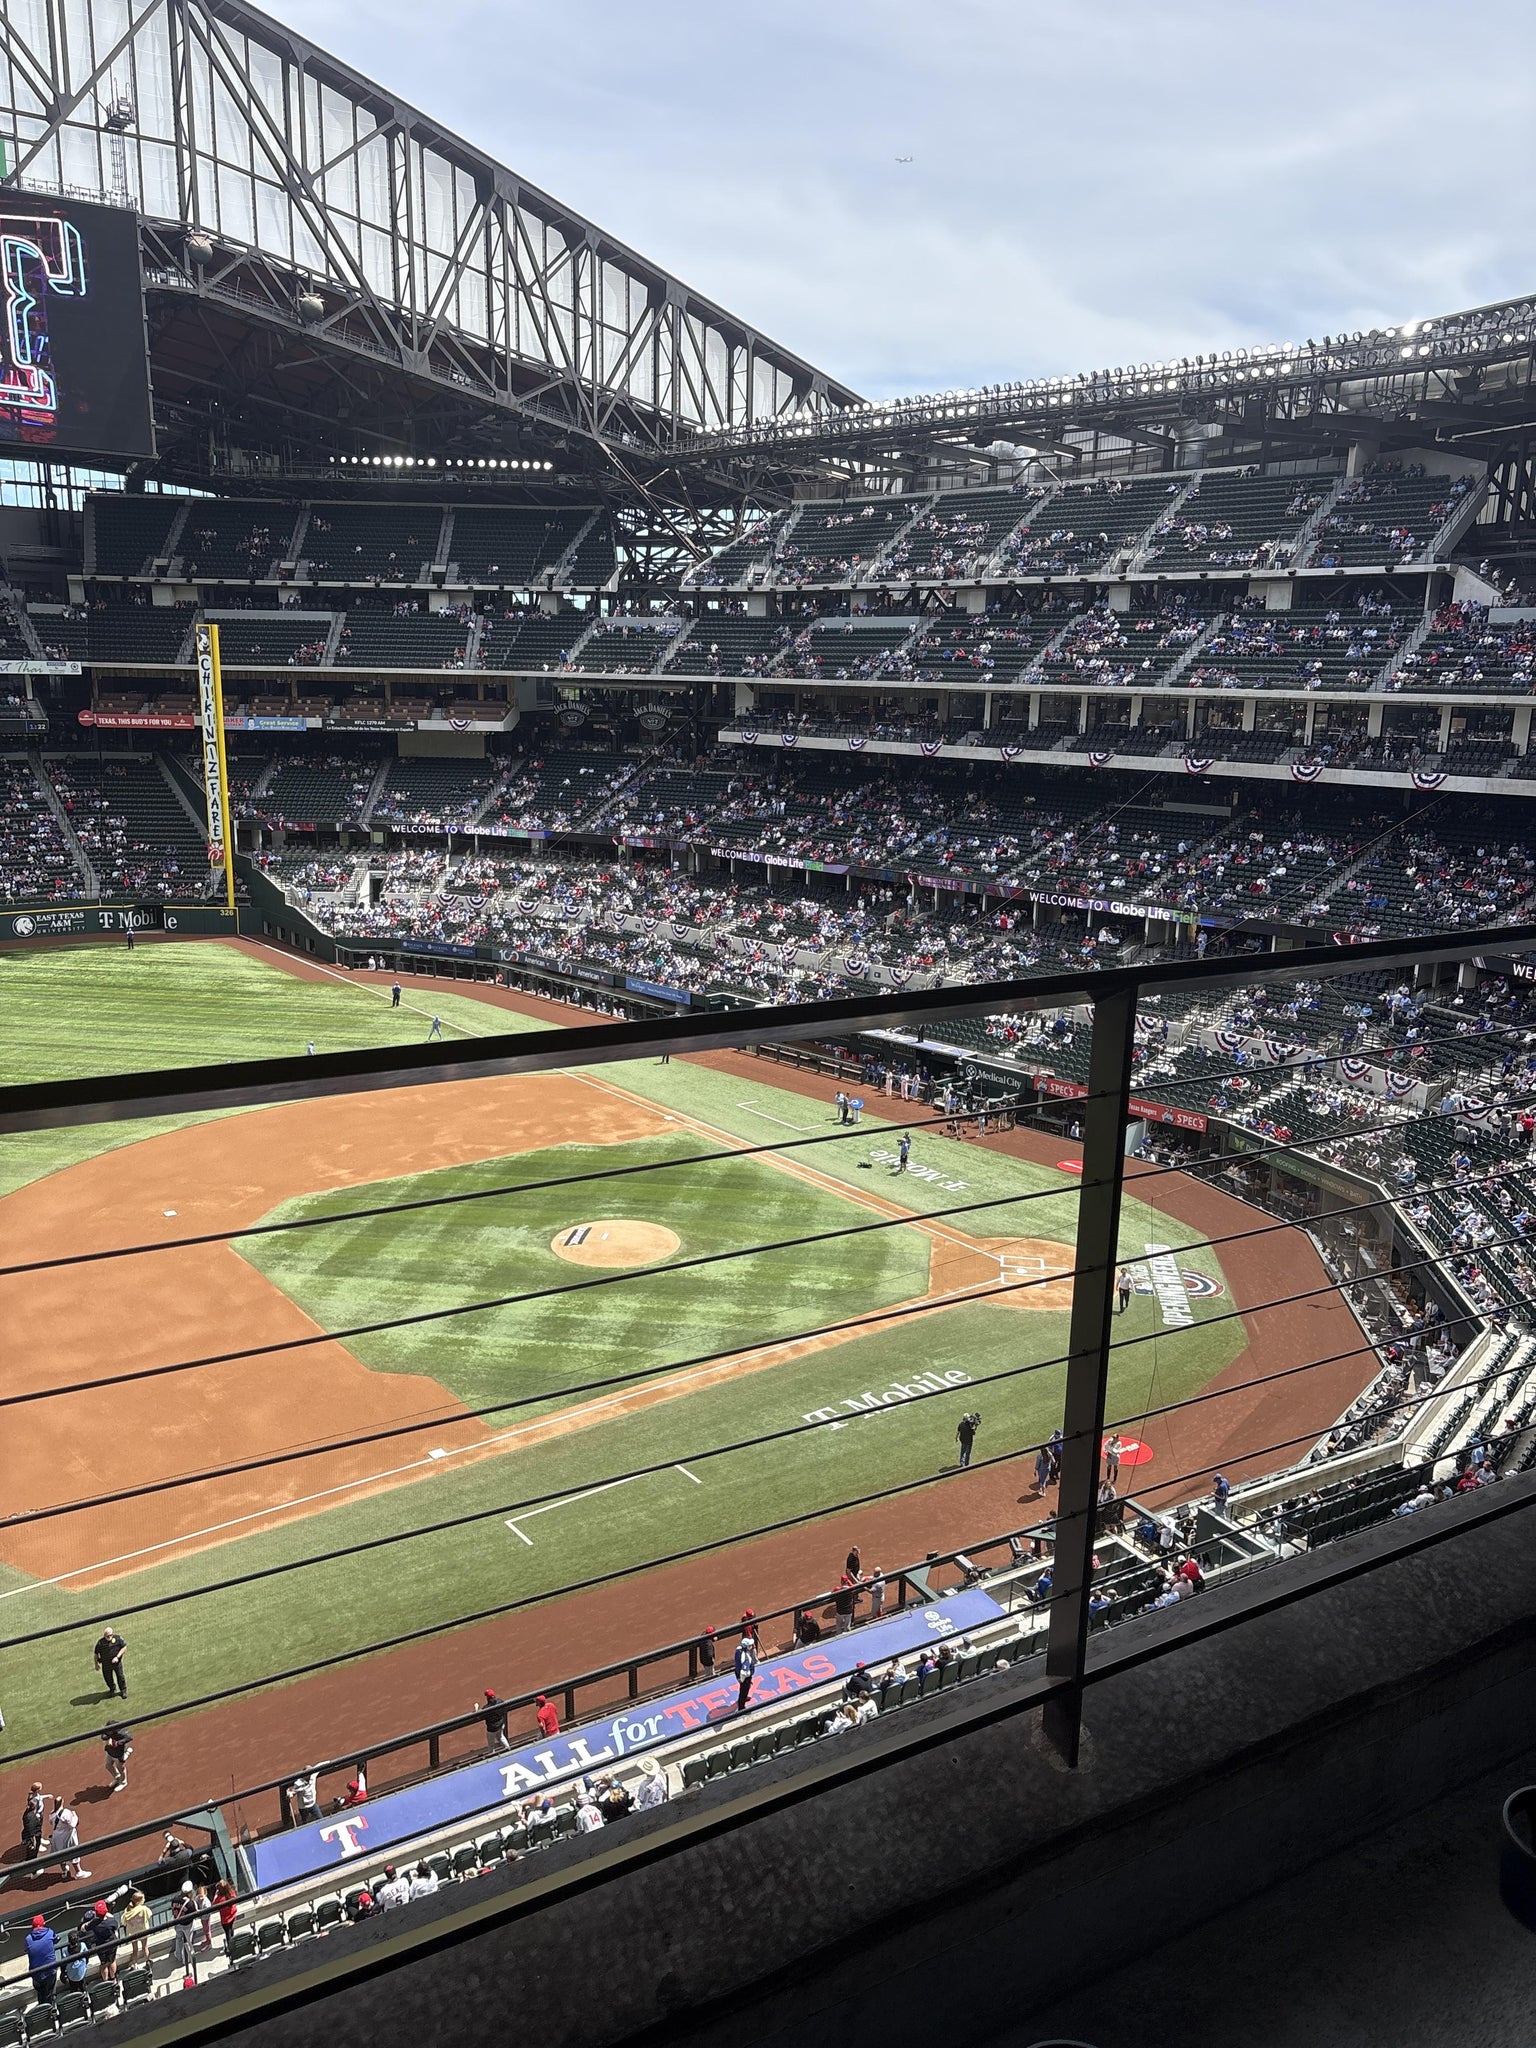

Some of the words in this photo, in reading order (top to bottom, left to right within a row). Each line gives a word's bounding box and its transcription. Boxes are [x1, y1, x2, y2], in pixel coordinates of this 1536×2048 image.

[553, 702, 568, 715] JACK
[633, 705, 648, 718] JACK
[131, 718, 148, 726] BUD'S
[208, 747, 217, 774] IZ
[210, 782, 221, 837] FARE
[391, 824, 440, 834] WELCOME
[444, 825, 458, 834] TO
[463, 825, 491, 836] Globe
[492, 826, 508, 837] Life
[710, 847, 748, 861] WELCOME
[749, 853, 760, 863] TO
[764, 854, 788, 867] Globe
[788, 857, 804, 869] Life
[1029, 891, 1083, 909] WELCOME
[1087, 899, 1103, 912] TO
[1110, 901, 1146, 917] Globe
[1147, 906, 1171, 921] Life
[1172, 910, 1200, 924] Field
[36, 914, 57, 922] EAST
[58, 912, 84, 920] TEXAS
[50, 920, 71, 928] A&M
[36, 926, 85, 934] UNIVERSITY
[524, 956, 546, 967] American
[577, 969, 600, 981] American
[978, 1069, 1006, 1085] Medical
[1006, 1076, 1022, 1090] City
[1050, 1083, 1074, 1097] SPEC'S
[1140, 1105, 1157, 1116] Rangers
[1176, 1114, 1204, 1128] SPEC'S
[1276, 1158, 1296, 1172] ROOFING
[1301, 1168, 1316, 1180] SIDING
[1321, 1177, 1345, 1194] WINDOWS
[1349, 1190, 1363, 1200] BATH
[1155, 1283, 1195, 1326] OPENING
[840, 1369, 972, 1419] Mobile
[499, 1738, 615, 1796] ALL
[608, 1714, 664, 1757] for
[662, 1655, 836, 1729] TEXAS
[588, 1812, 600, 1825] 14
